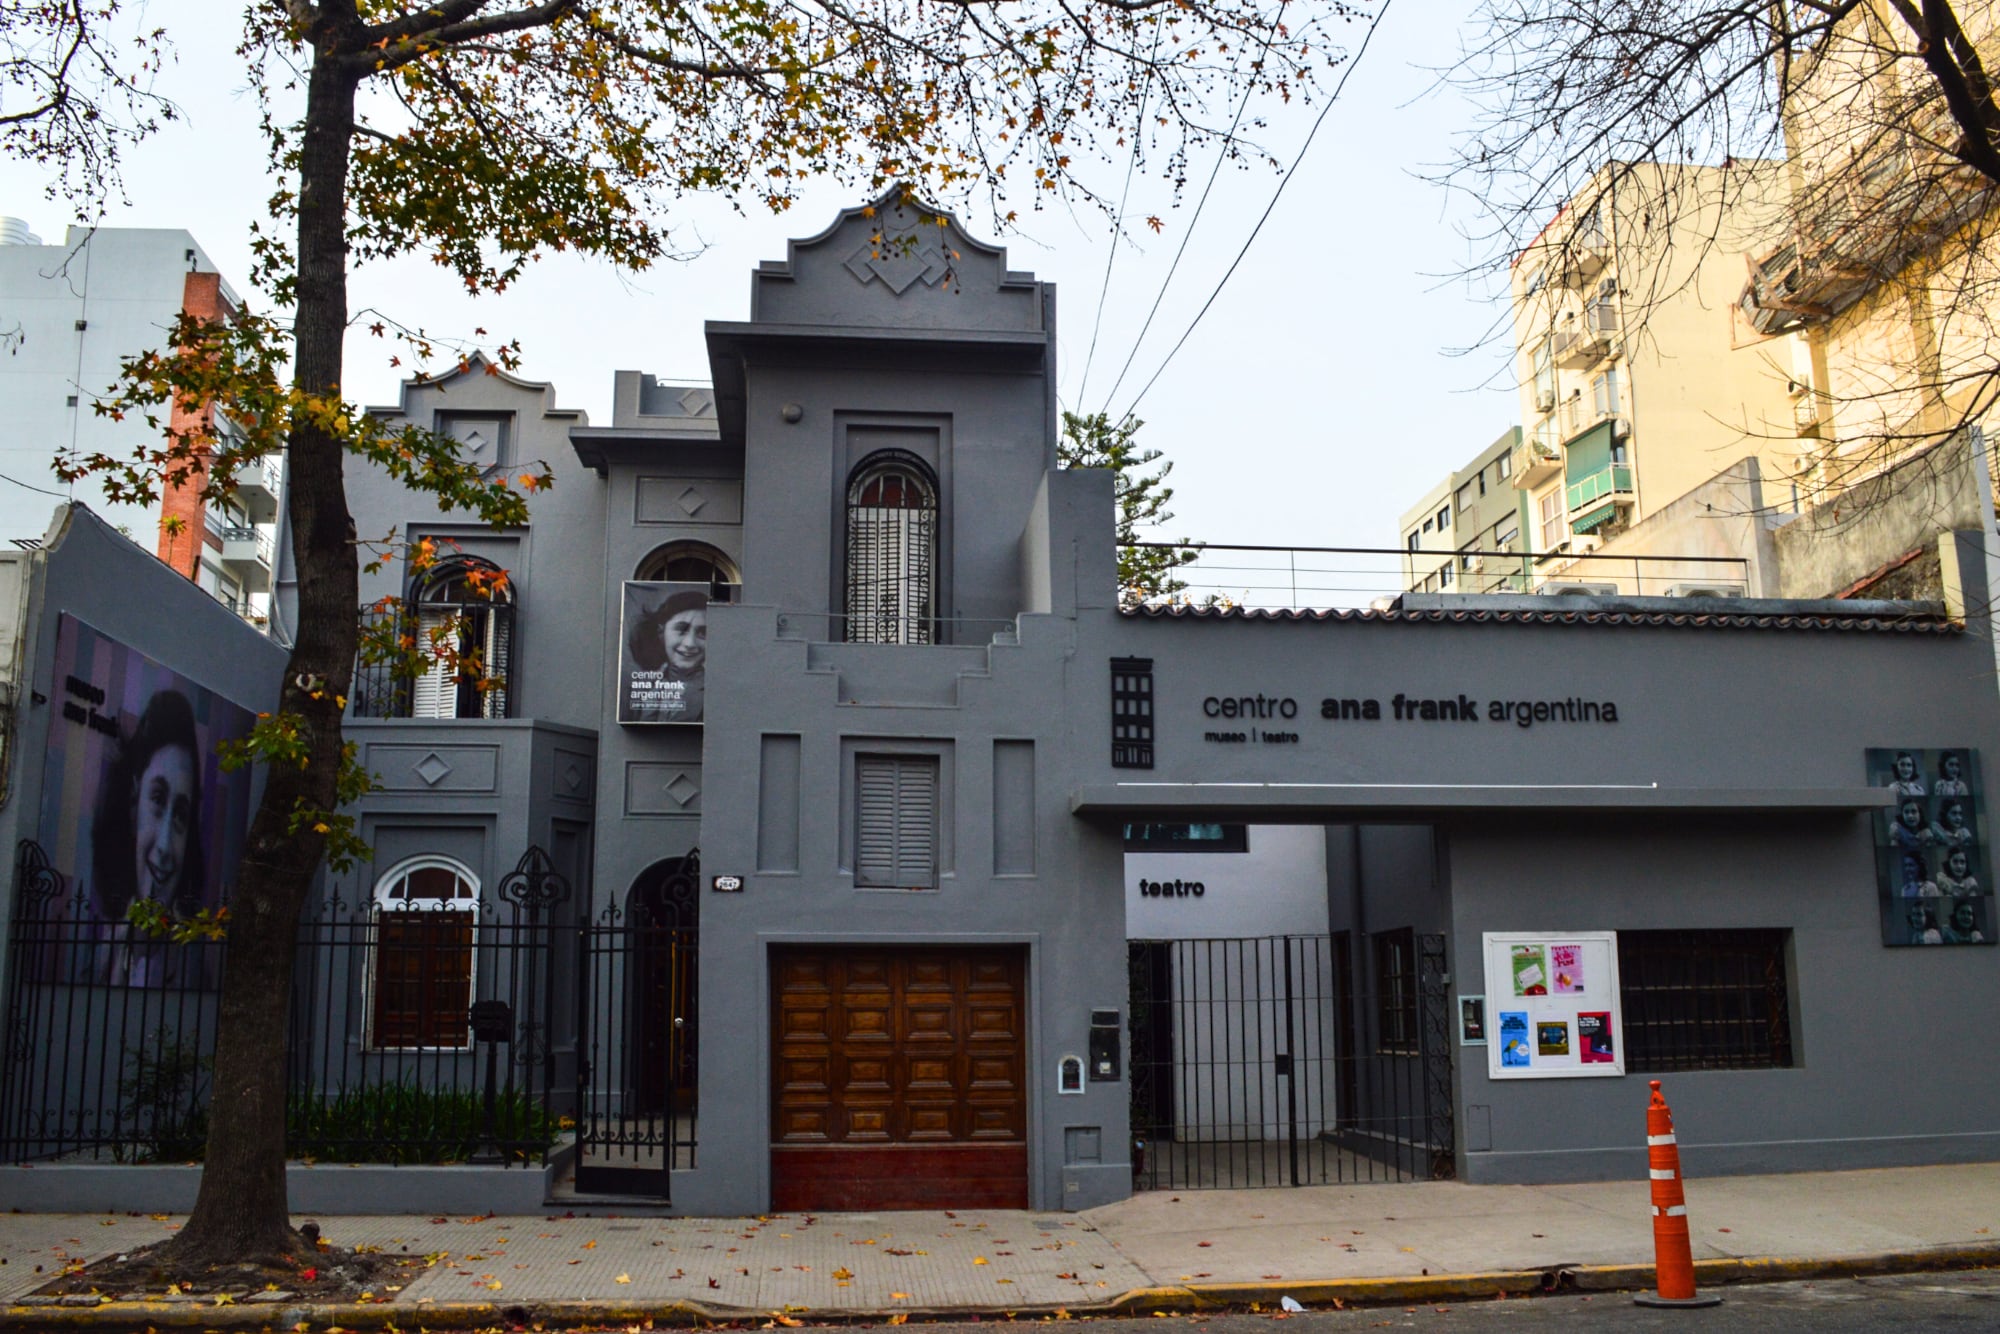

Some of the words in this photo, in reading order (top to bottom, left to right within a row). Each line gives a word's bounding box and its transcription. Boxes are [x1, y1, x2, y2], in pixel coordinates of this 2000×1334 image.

[631, 671, 664, 680] centro
[631, 681, 652, 689] ana
[655, 680, 685, 690] frank
[630, 690, 681, 701] argentina
[1203, 693, 1298, 719] centro
[1321, 698, 1381, 720] ana
[1392, 694, 1478, 721] frank
[1488, 697, 1618, 728] argentina
[1204, 731, 1247, 743] museo
[1262, 731, 1299, 743] teatro
[1139, 878, 1205, 898] teatro
